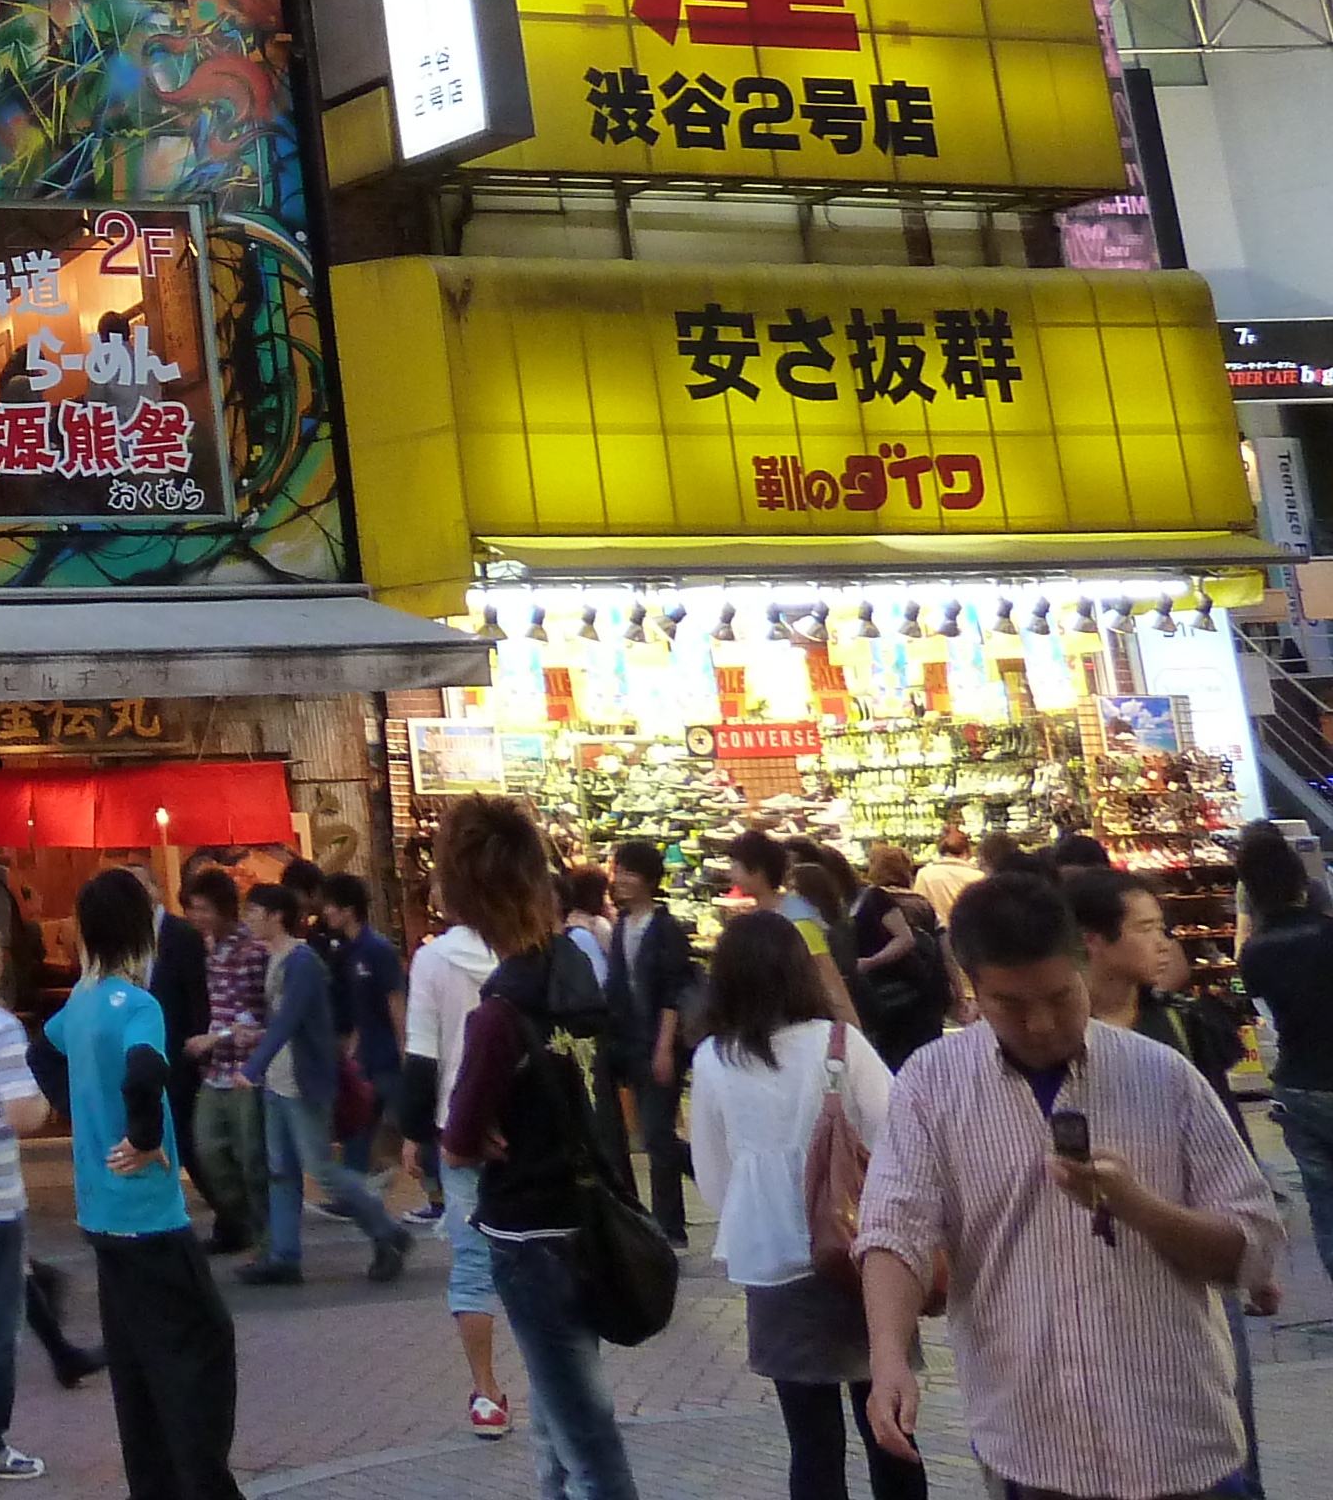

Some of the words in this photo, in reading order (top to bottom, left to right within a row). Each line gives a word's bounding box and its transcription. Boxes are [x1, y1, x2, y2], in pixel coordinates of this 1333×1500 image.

[585, 65, 938, 158] 渋谷2号店
[94, 209, 175, 279] 2F
[25, 325, 182, 391] らーめん
[674, 303, 1023, 404] 安さ抜群
[1266, 370, 1299, 385] CAFE
[107, 478, 206, 511] おくむら
[751, 442, 985, 513] 靴のダイワ
[717, 729, 817, 749] CONVERSE
